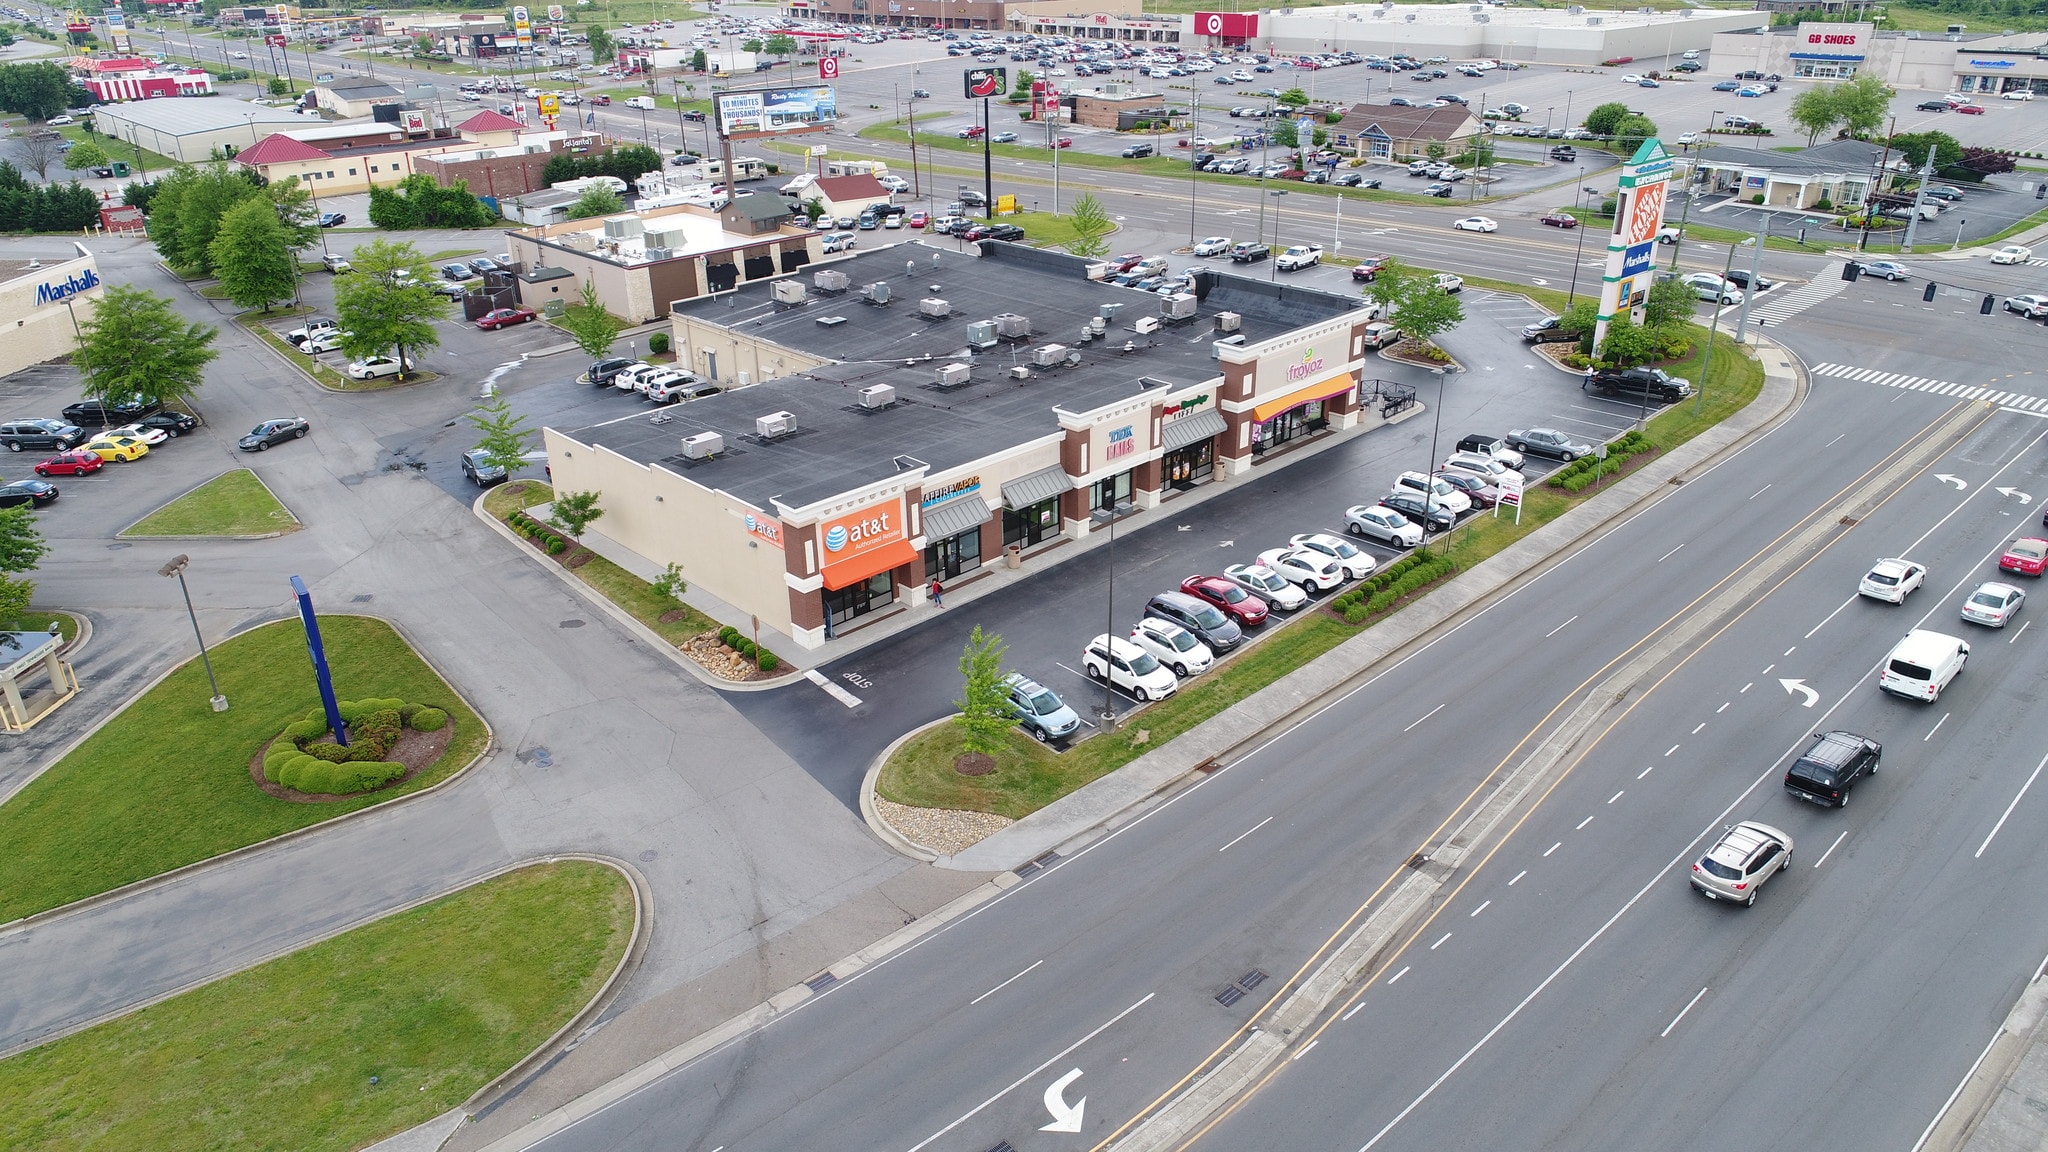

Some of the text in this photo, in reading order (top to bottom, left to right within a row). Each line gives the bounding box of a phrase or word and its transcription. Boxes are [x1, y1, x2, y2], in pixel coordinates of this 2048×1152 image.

[1808, 34, 1856, 45] GB SHOES
[722, 98, 759, 108] 10 MINUTES
[723, 109, 763, 119] THOUSANDS!
[1635, 170, 1673, 186] EXCHANGE
[1628, 184, 1663, 244] HOME
[1623, 251, 1651, 268] Marshalls
[34, 269, 100, 307] Marshalls
[1288, 358, 1323, 380] froyoz
[756, 521, 777, 541] at&t
[850, 511, 889, 542] at&t
[855, 528, 901, 551] Authorized Retailer
[842, 672, 873, 689] STOP
